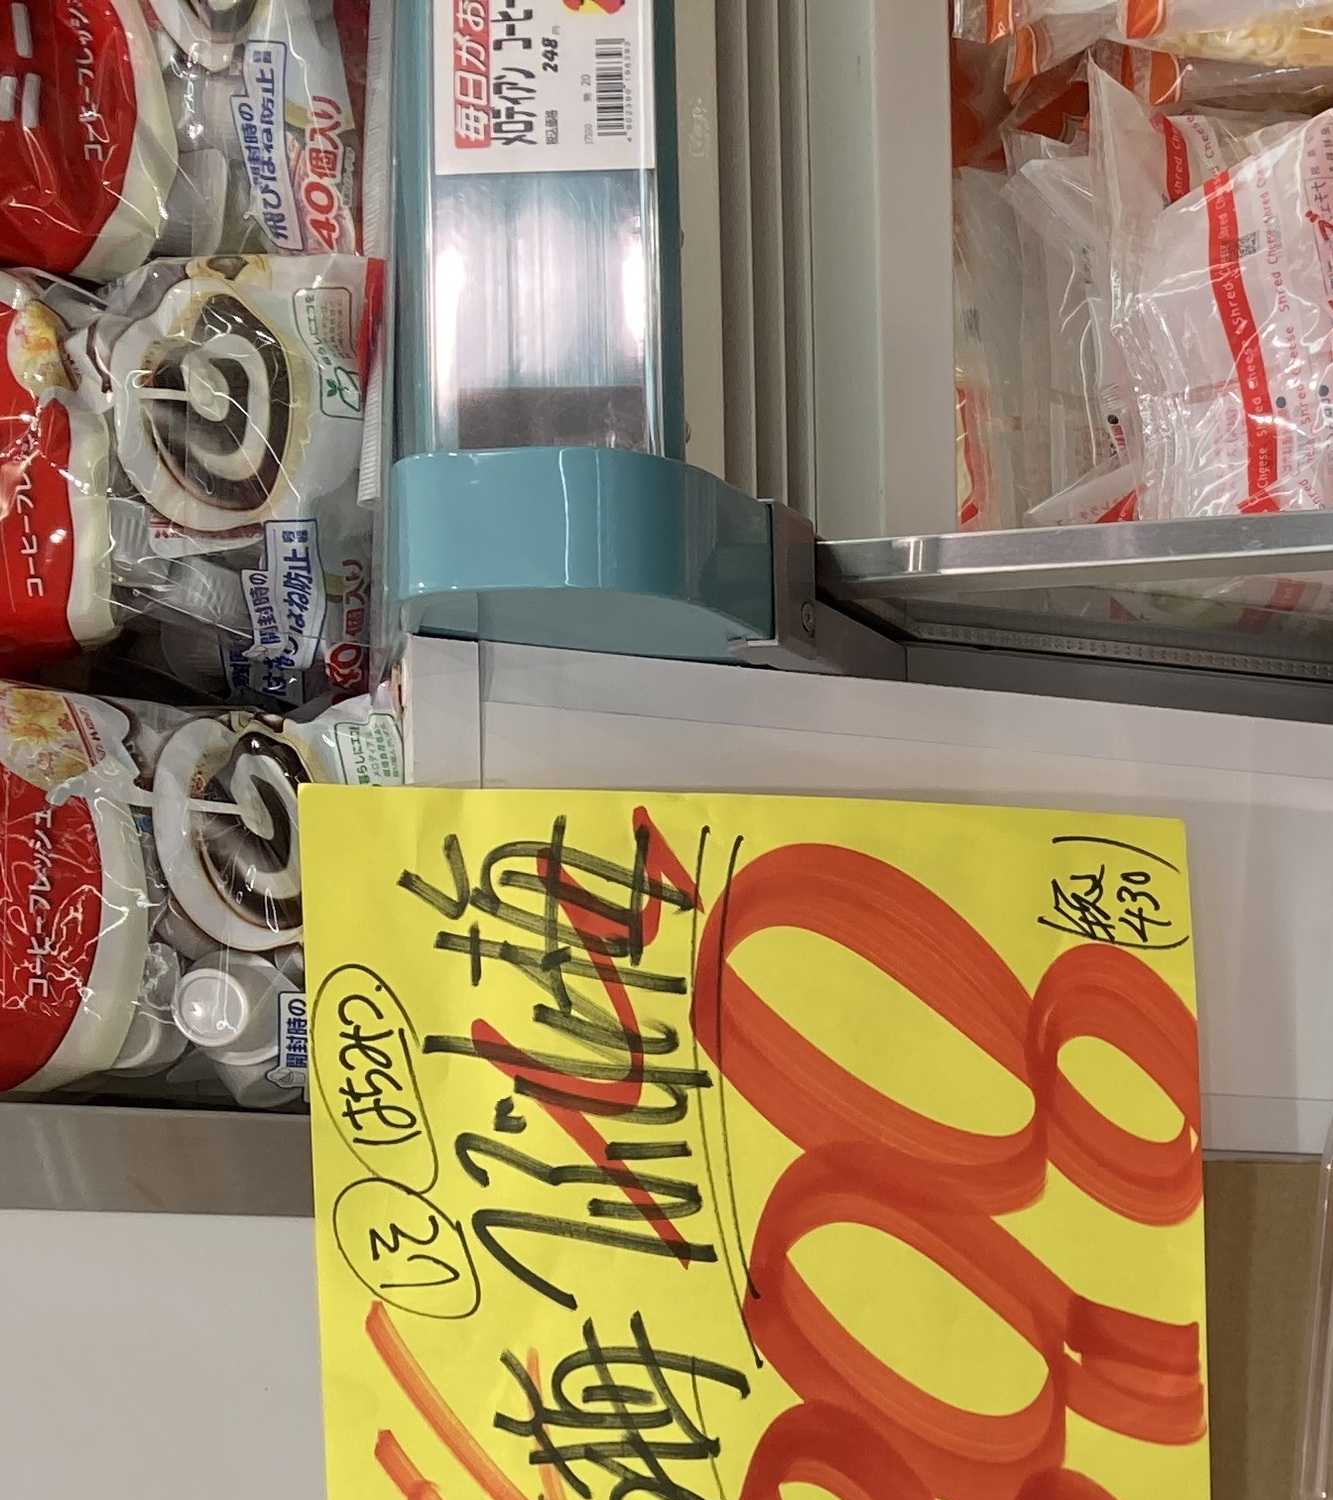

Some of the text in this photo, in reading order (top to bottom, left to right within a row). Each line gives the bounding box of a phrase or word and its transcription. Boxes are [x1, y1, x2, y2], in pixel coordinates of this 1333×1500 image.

[541, 37, 559, 72] 248
[490, 67, 537, 145] メロディアン
[303, 95, 341, 250] 40個入り
[248, 571, 281, 644] 開封時の
[26, 805, 54, 998] コーヒーフレッシュ
